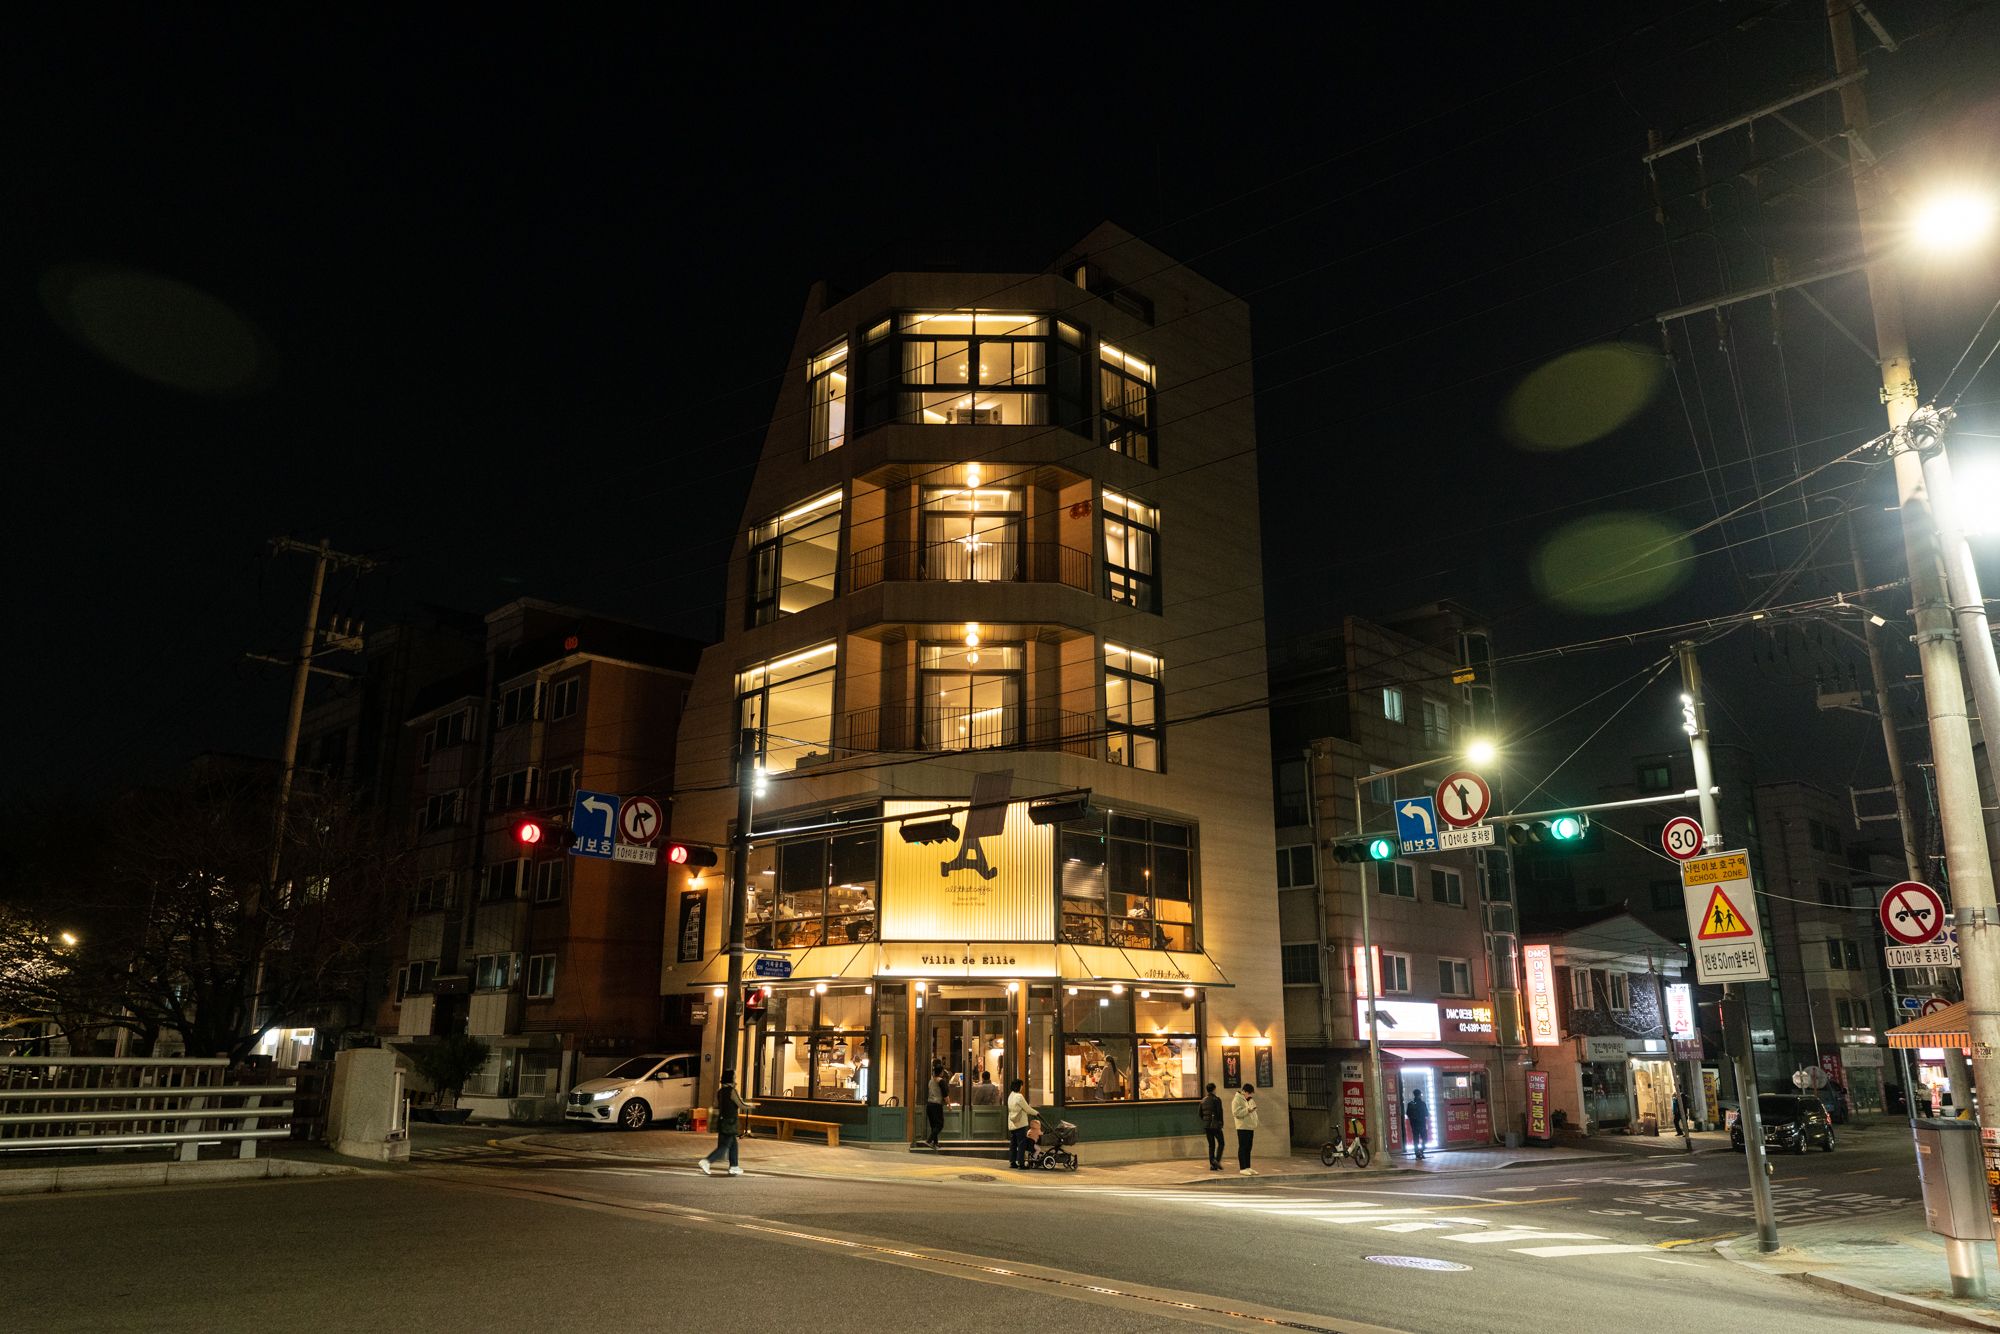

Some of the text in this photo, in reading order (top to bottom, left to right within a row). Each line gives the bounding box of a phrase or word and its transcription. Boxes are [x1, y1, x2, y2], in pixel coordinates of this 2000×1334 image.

[572, 836, 612, 854] 비보호
[1402, 838, 1436, 852] 비보호
[1442, 830, 1490, 847] 10t이상 중차량
[1670, 829, 1696, 850] 30
[1684, 857, 1746, 873] 어린이보호구역
[1690, 869, 1743, 882] SCHOOL ZONE
[922, 956, 1016, 965] Villa de Ellie
[1528, 949, 1547, 958] DMC
[1890, 948, 1948, 965] 10t이상 중차량
[1446, 1008, 1459, 1019] DMC
[1672, 995, 1689, 1032] 부동산
[1532, 1092, 1545, 1132] 부동산
